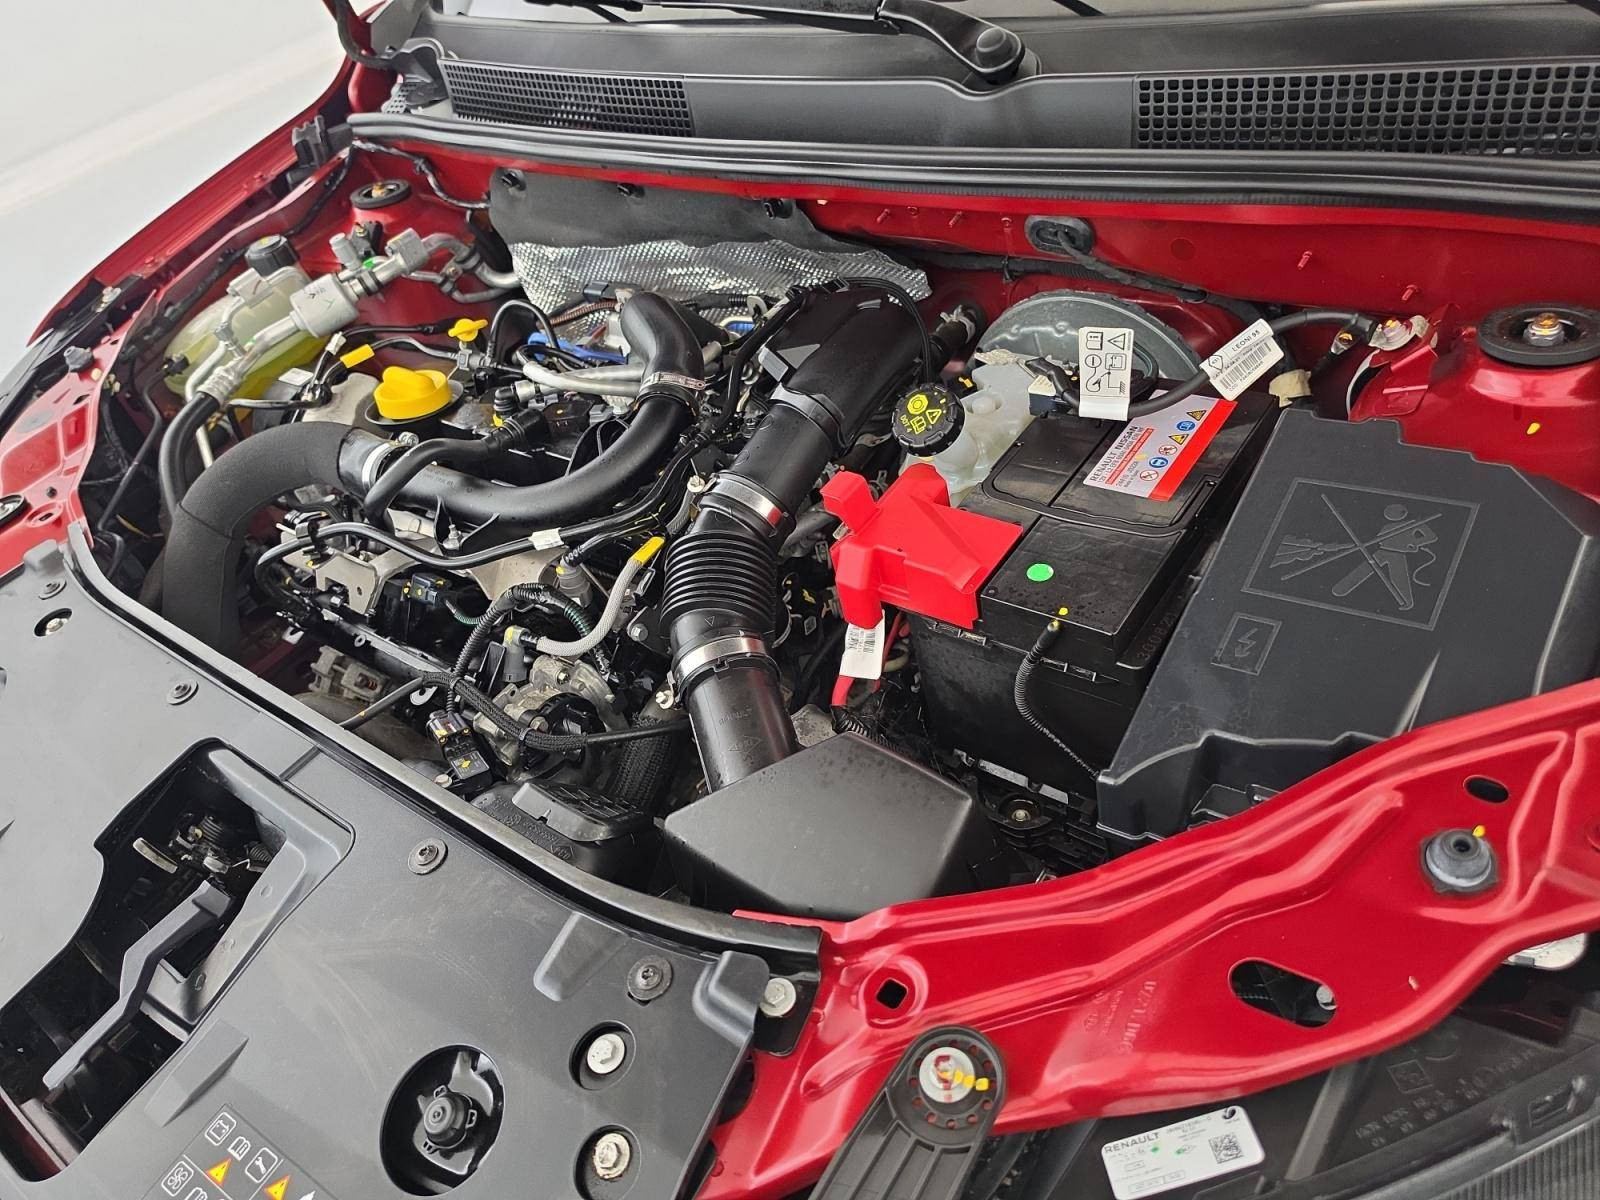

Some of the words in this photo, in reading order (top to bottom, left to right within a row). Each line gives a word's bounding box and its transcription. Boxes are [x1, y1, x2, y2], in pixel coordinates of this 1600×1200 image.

[1231, 335, 1253, 352] LEONI
[900, 414, 910, 427] DOT
[1089, 451, 1117, 482] RENAULT
[1114, 425, 1139, 450] NISSAN
[1104, 1131, 1160, 1154] RENAULT
